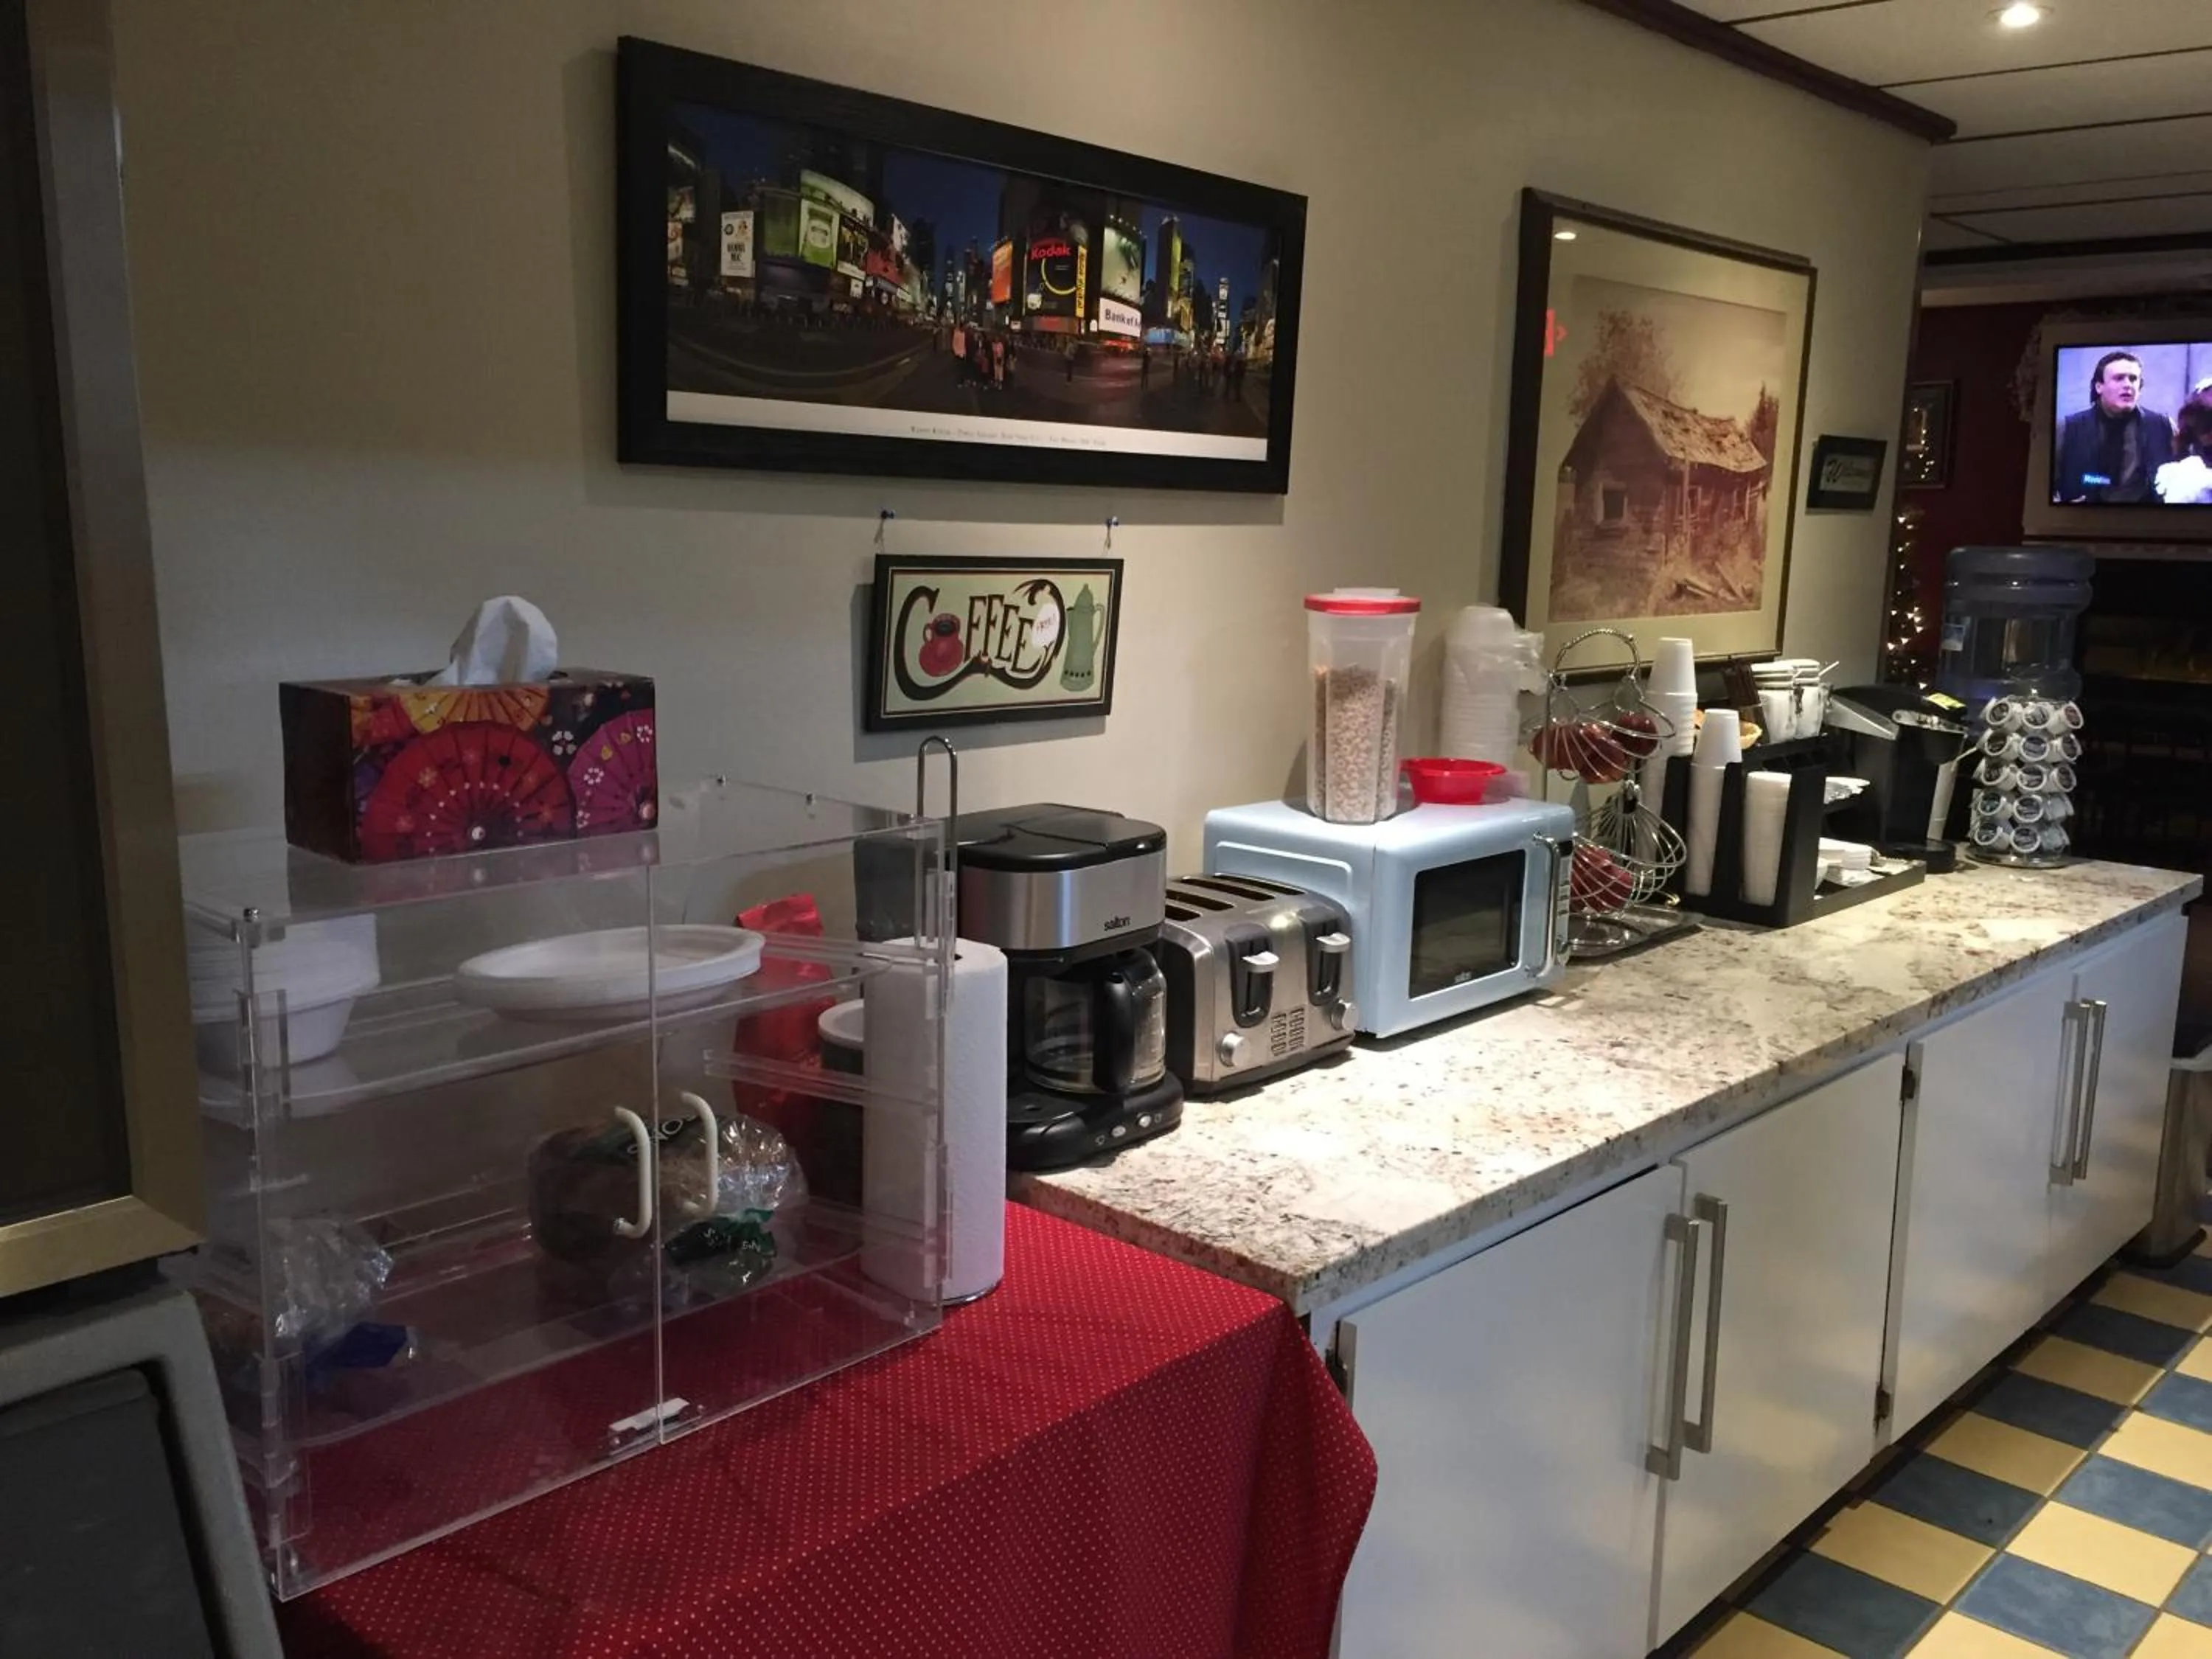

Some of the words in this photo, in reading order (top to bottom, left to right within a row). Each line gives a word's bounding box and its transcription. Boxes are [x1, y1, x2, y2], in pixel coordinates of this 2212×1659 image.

[1031, 244, 1071, 259] Kodak
[1105, 308, 1126, 324] Bank
[1104, 915, 1131, 931] salton
